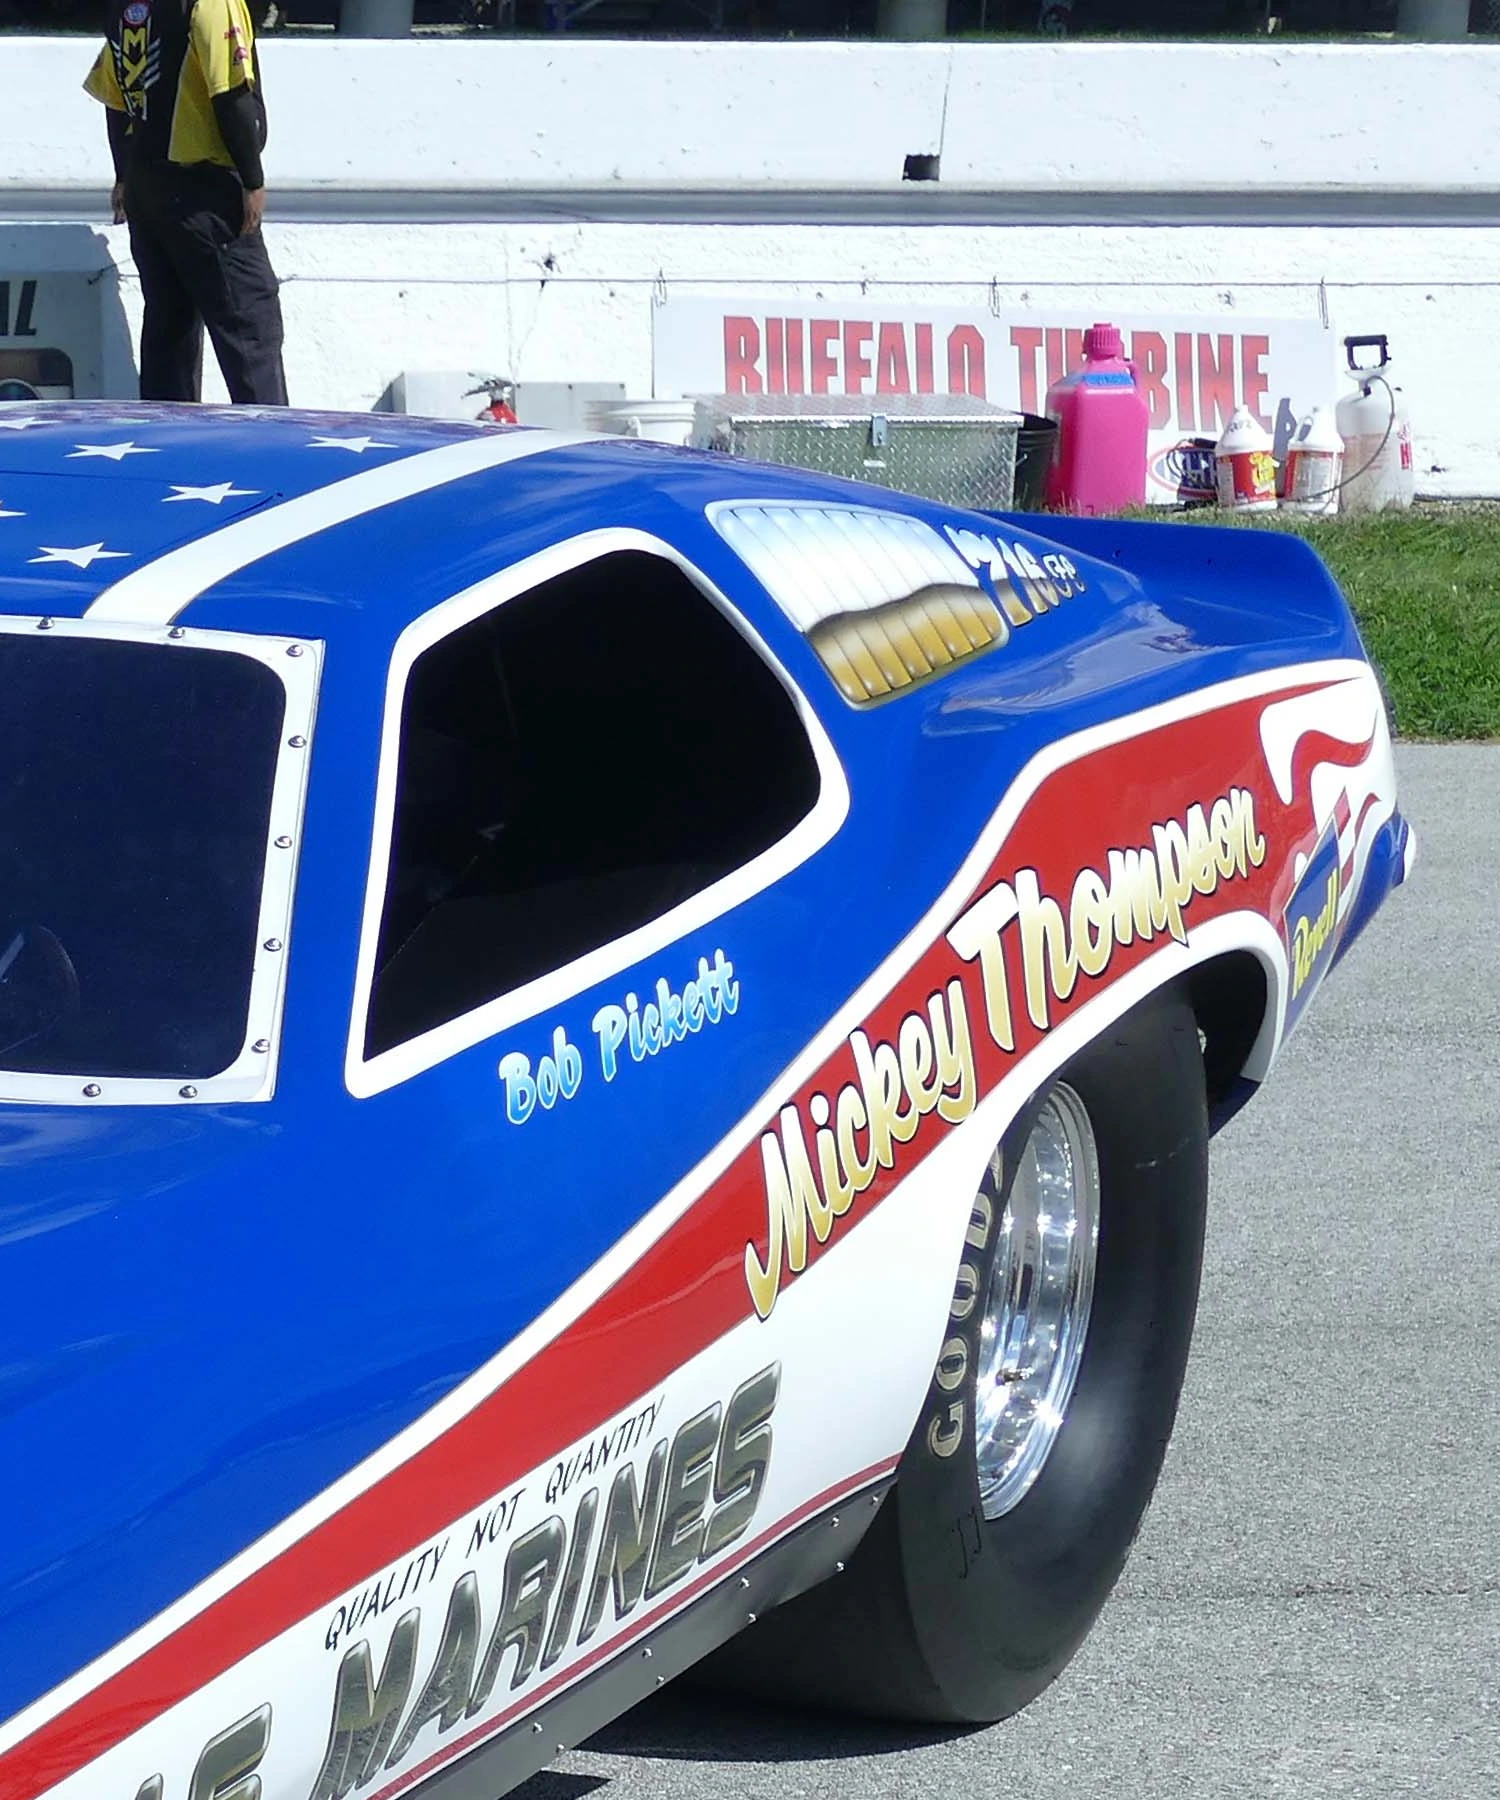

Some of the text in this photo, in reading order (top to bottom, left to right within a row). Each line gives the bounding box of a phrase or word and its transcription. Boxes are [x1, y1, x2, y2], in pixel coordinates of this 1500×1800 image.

[1009, 325, 1270, 433] TUBINE
[499, 948, 740, 1126] Bob Pickett
[744, 786, 1266, 1320] Mickey Thompson
[324, 1394, 666, 1651] QUALITY NOT QUANTITY
